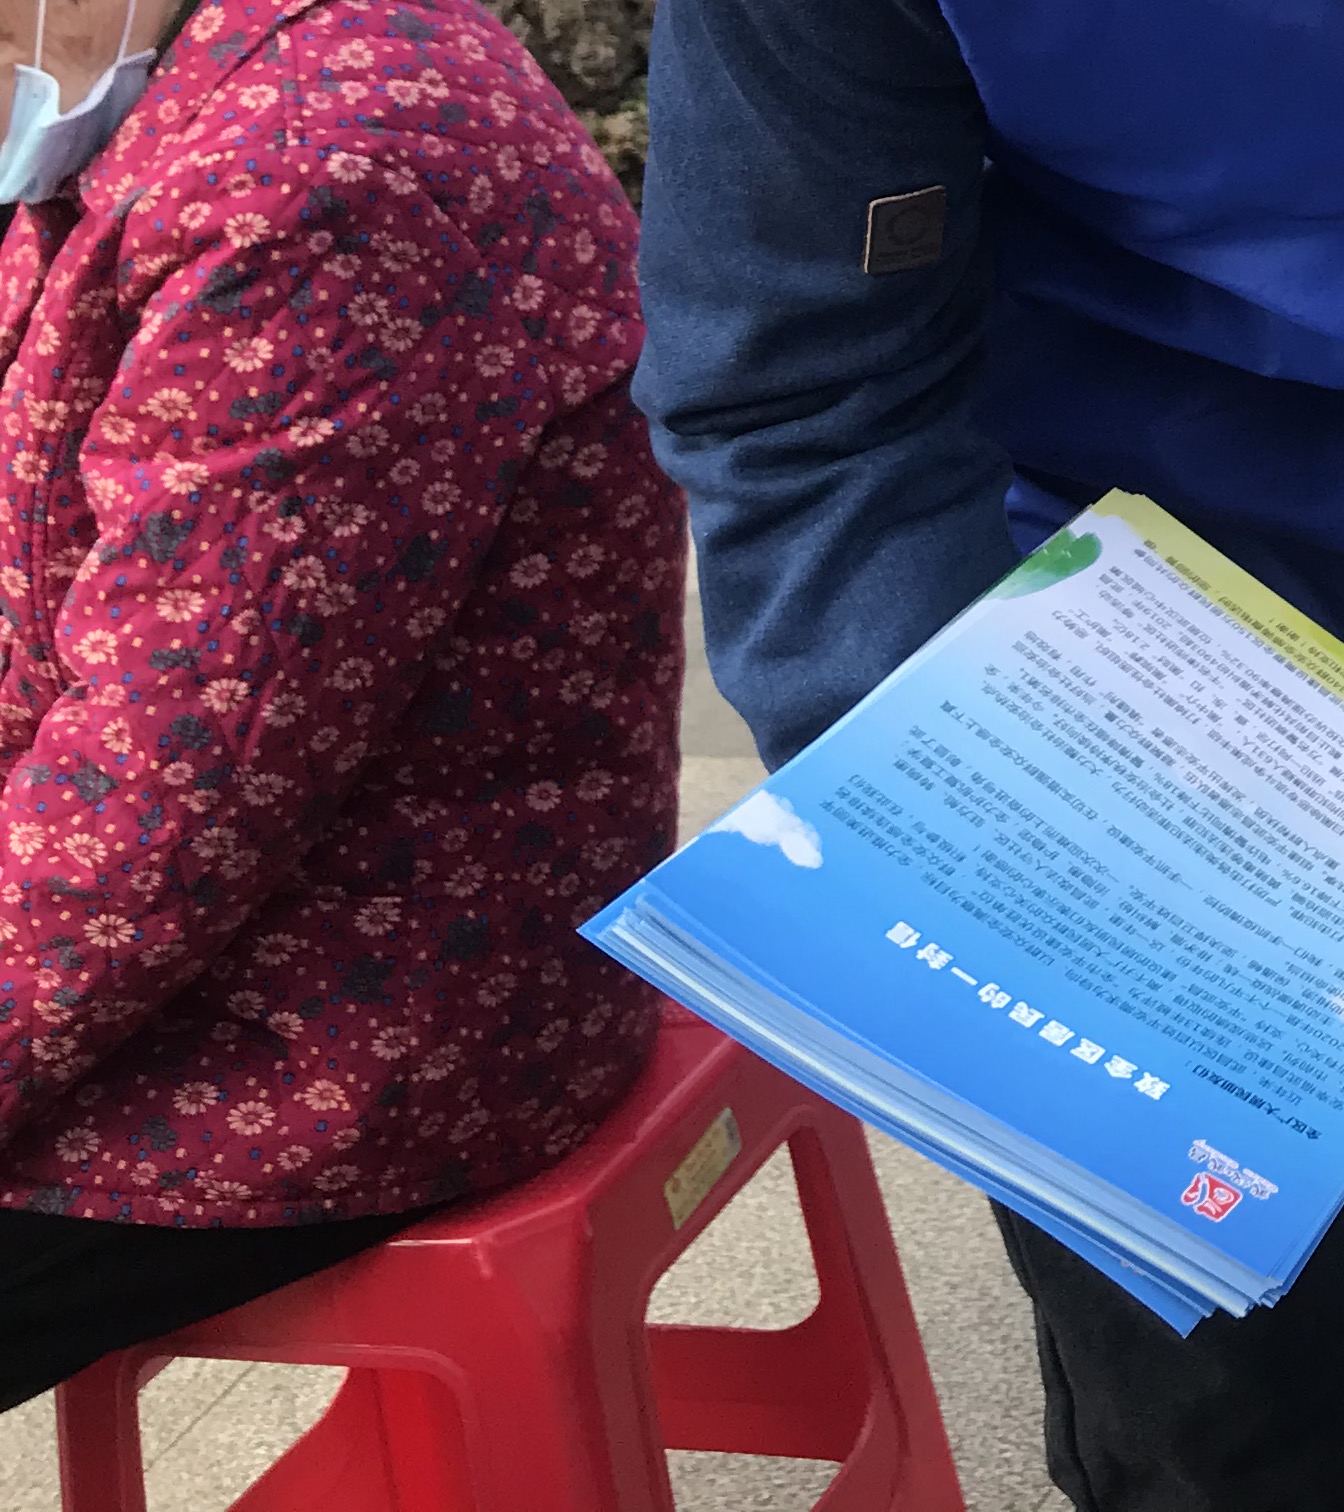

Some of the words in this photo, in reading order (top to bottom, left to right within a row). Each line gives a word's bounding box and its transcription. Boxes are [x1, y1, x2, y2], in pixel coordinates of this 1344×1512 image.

[880, 920, 1172, 1101] 致全区居民的一封信
